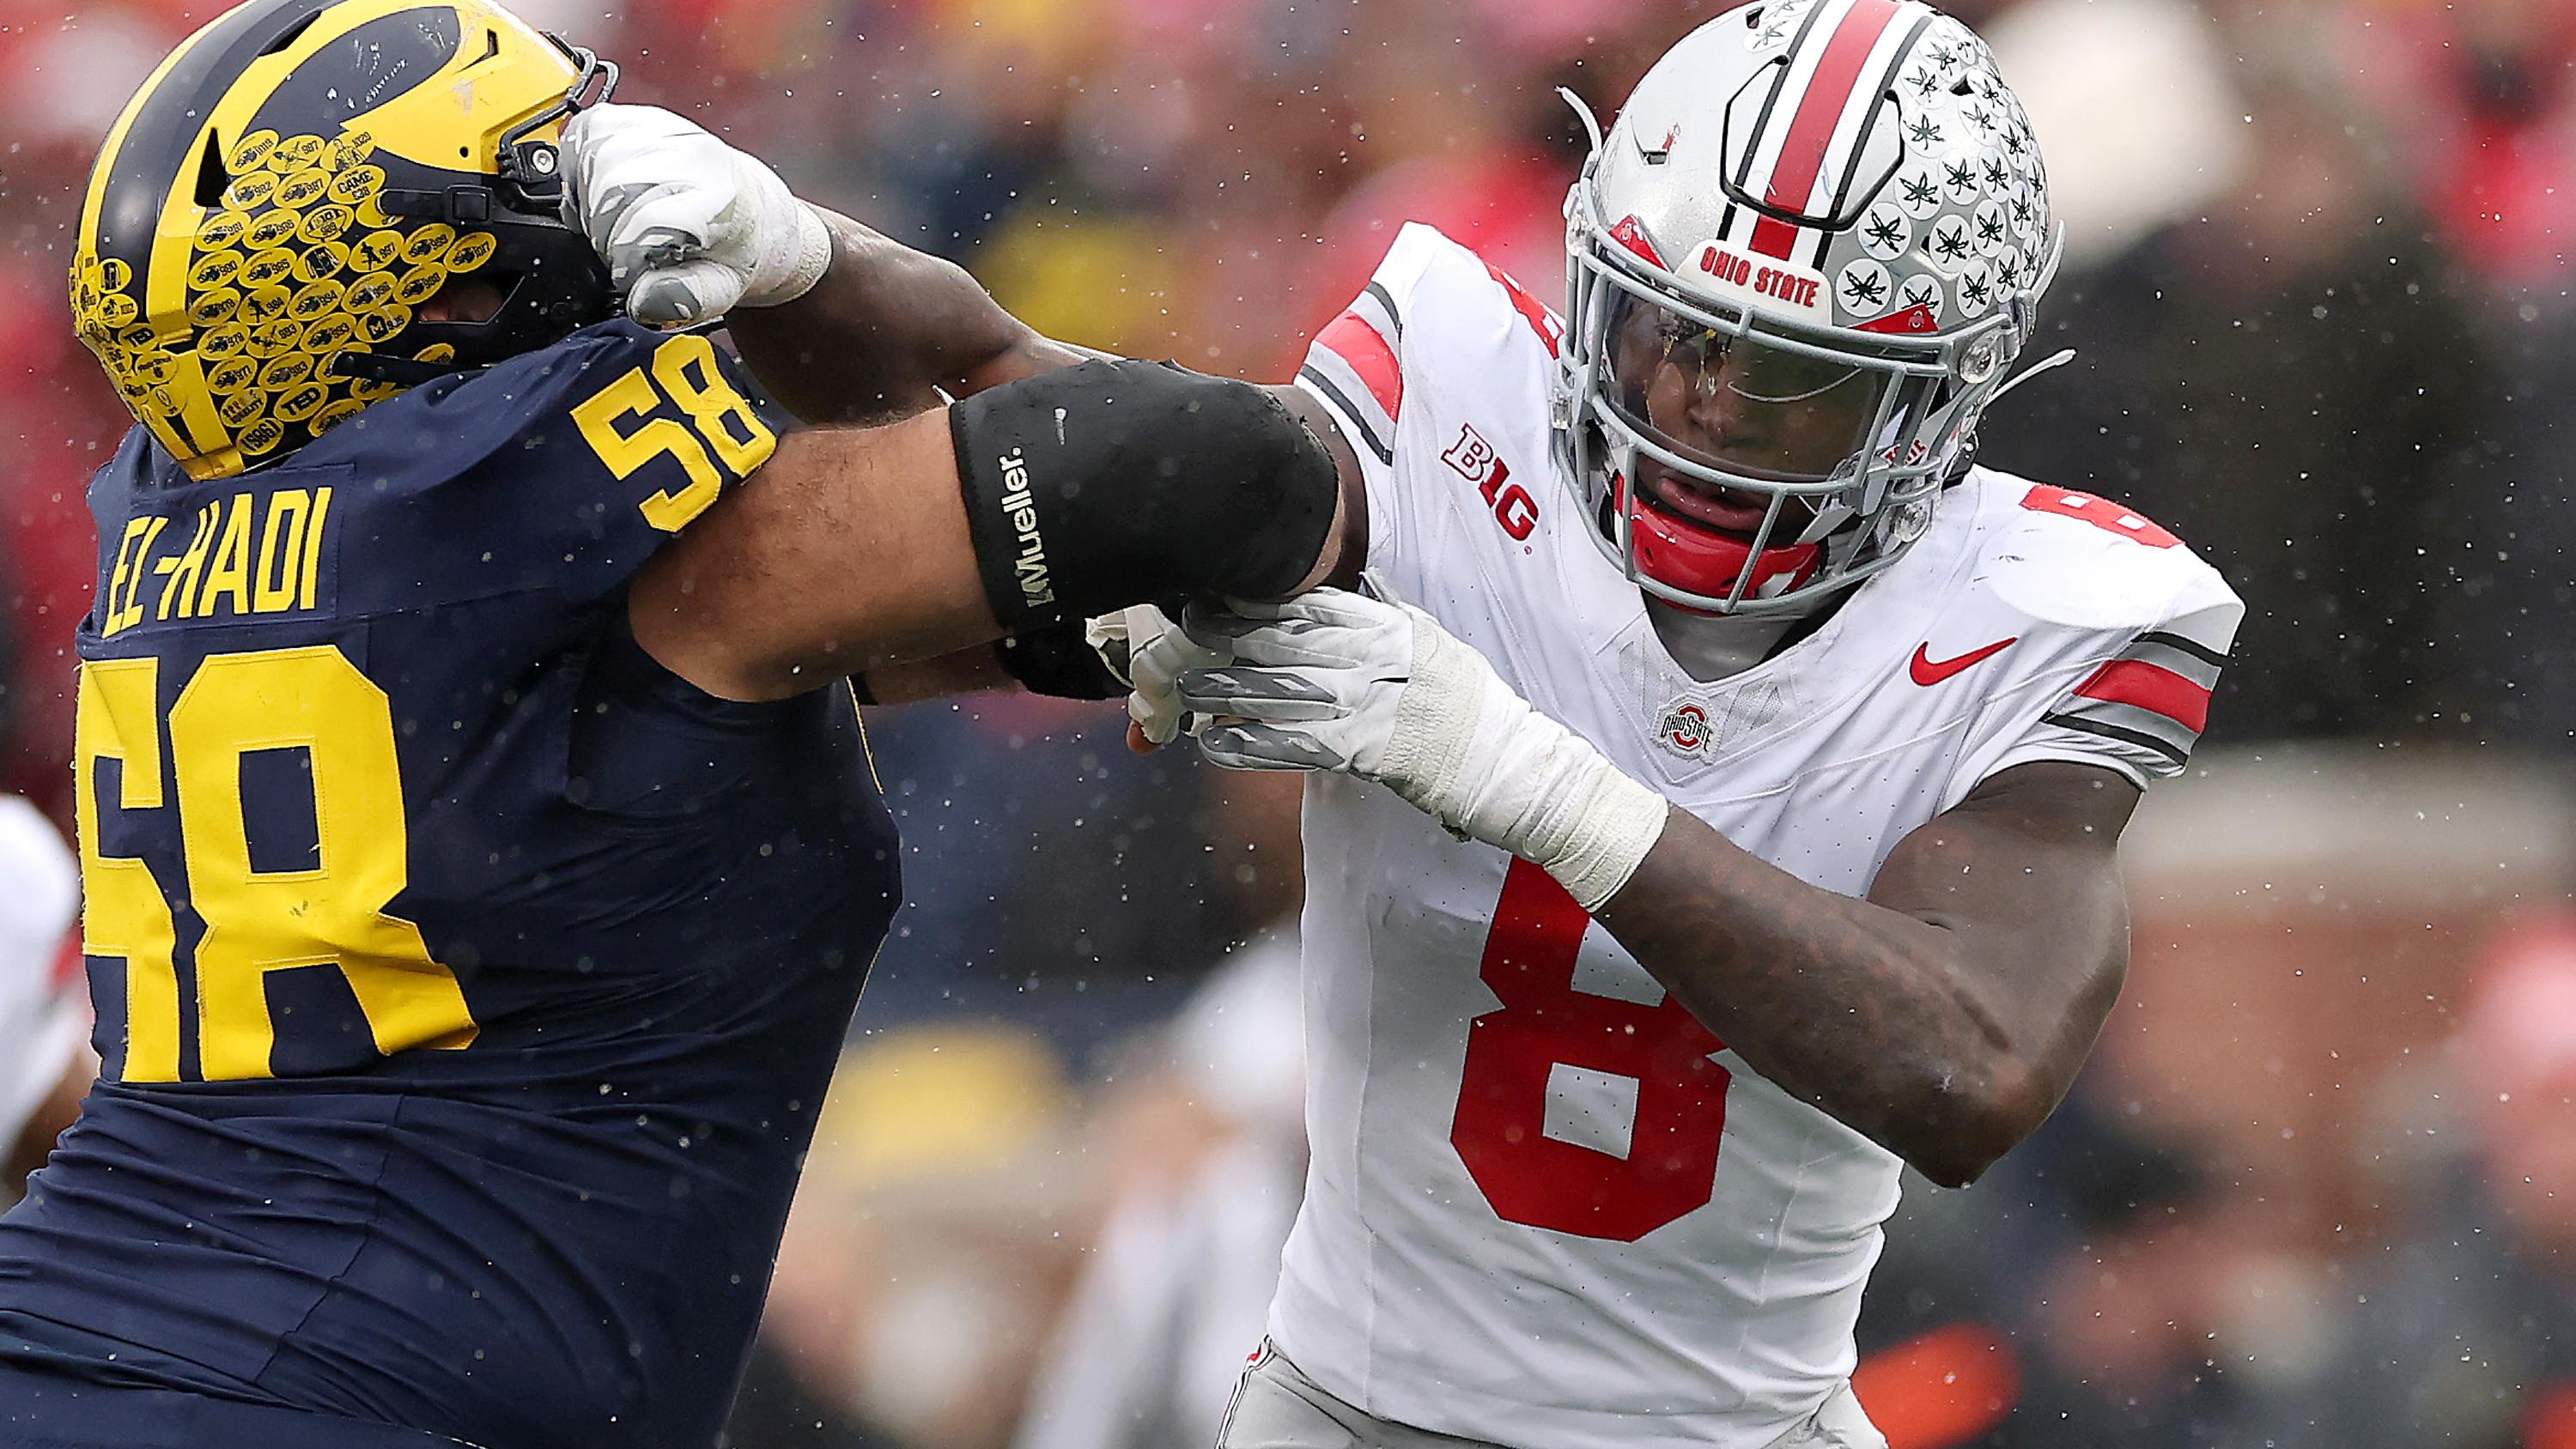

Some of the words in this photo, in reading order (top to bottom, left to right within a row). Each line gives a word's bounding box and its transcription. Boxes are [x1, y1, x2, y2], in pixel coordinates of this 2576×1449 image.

[337, 172, 374, 194] GAME
[1699, 246, 1751, 286] OHIO
[1754, 266, 1820, 308] STATE
[369, 320, 382, 336] M
[281, 387, 320, 415] TED
[569, 332, 777, 533] 58
[101, 486, 332, 640] EL-HADI
[1660, 715, 1686, 738] OHIO
[1684, 715, 1714, 753] STATE
[74, 644, 481, 1083] 58
[1449, 852, 1732, 1243] 8
